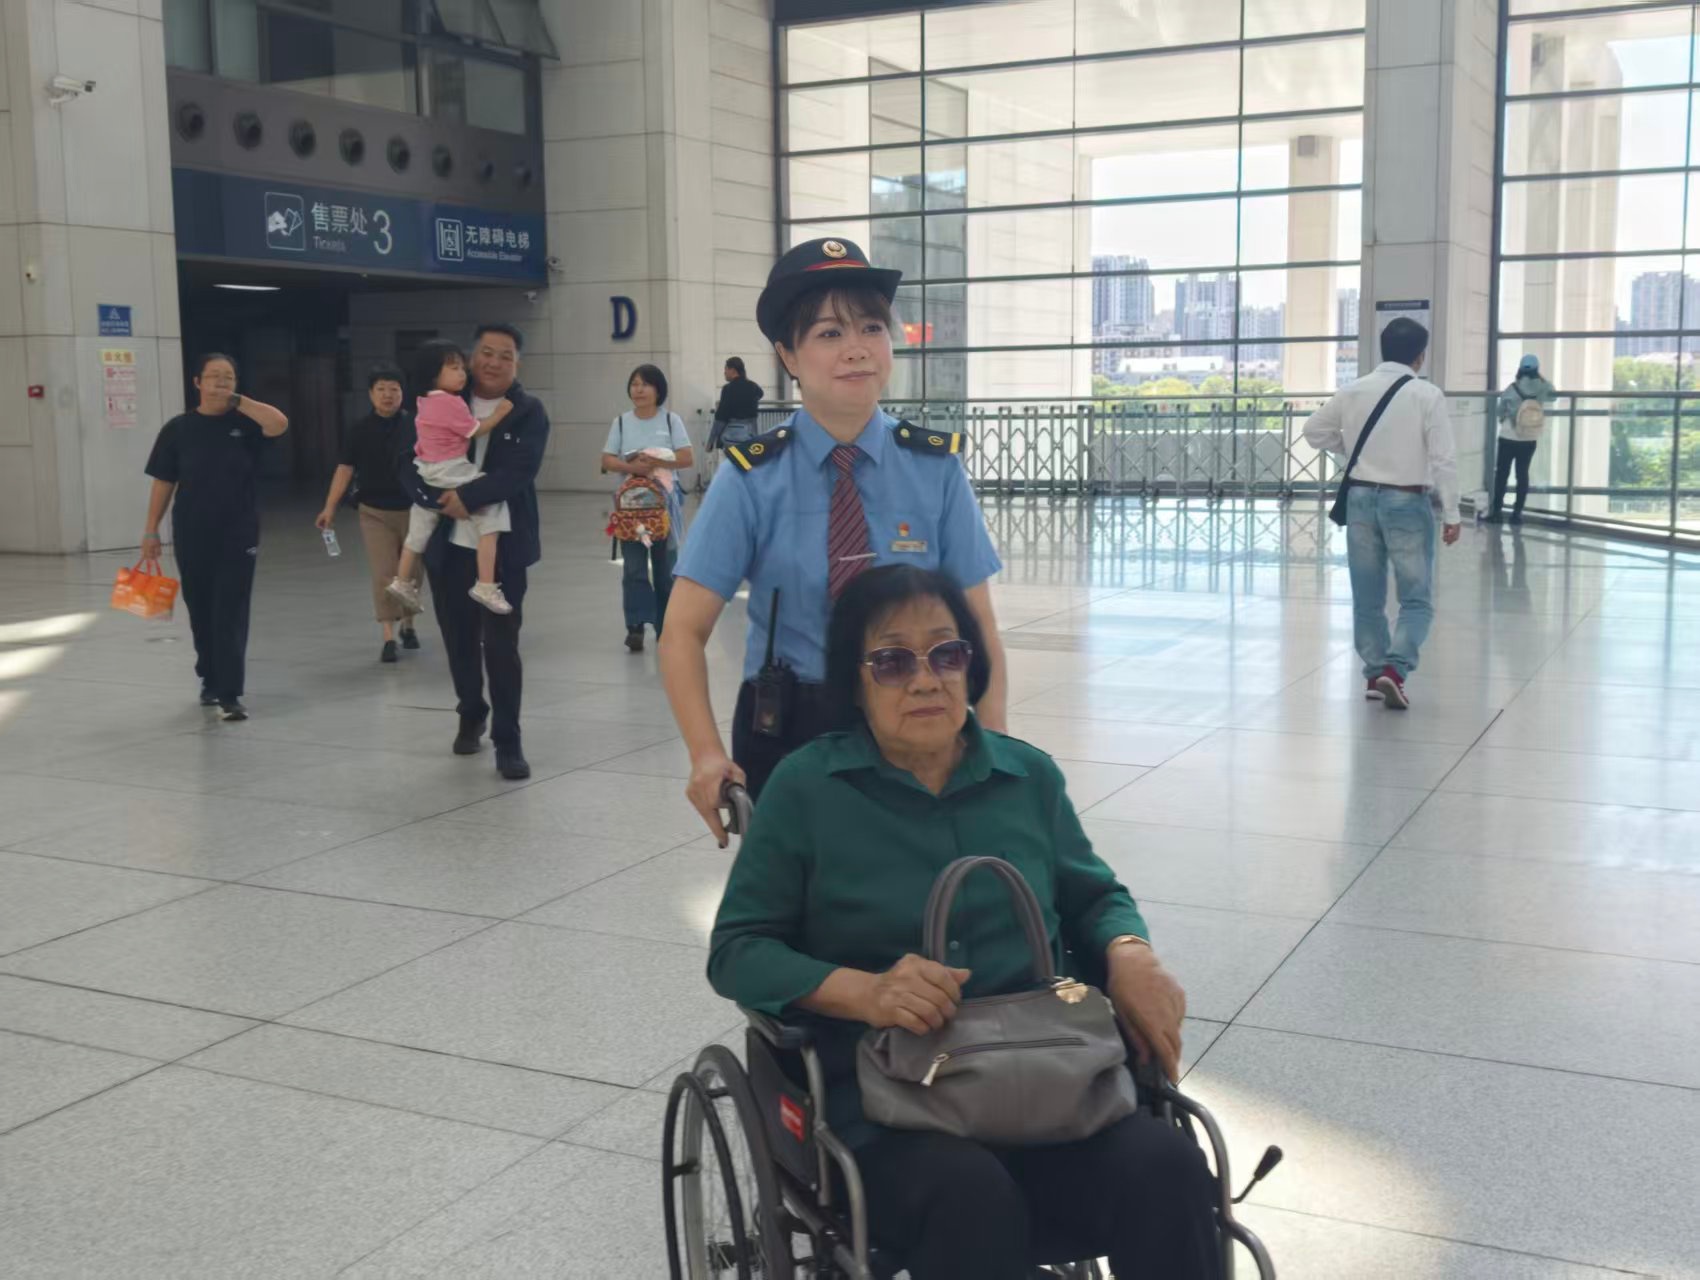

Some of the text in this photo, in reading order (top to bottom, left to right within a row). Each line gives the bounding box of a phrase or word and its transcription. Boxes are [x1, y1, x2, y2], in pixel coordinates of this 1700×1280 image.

[311, 202, 393, 255] 售票处 3
[465, 225, 530, 249] 无障碍电梯
[610, 296, 638, 341] D
